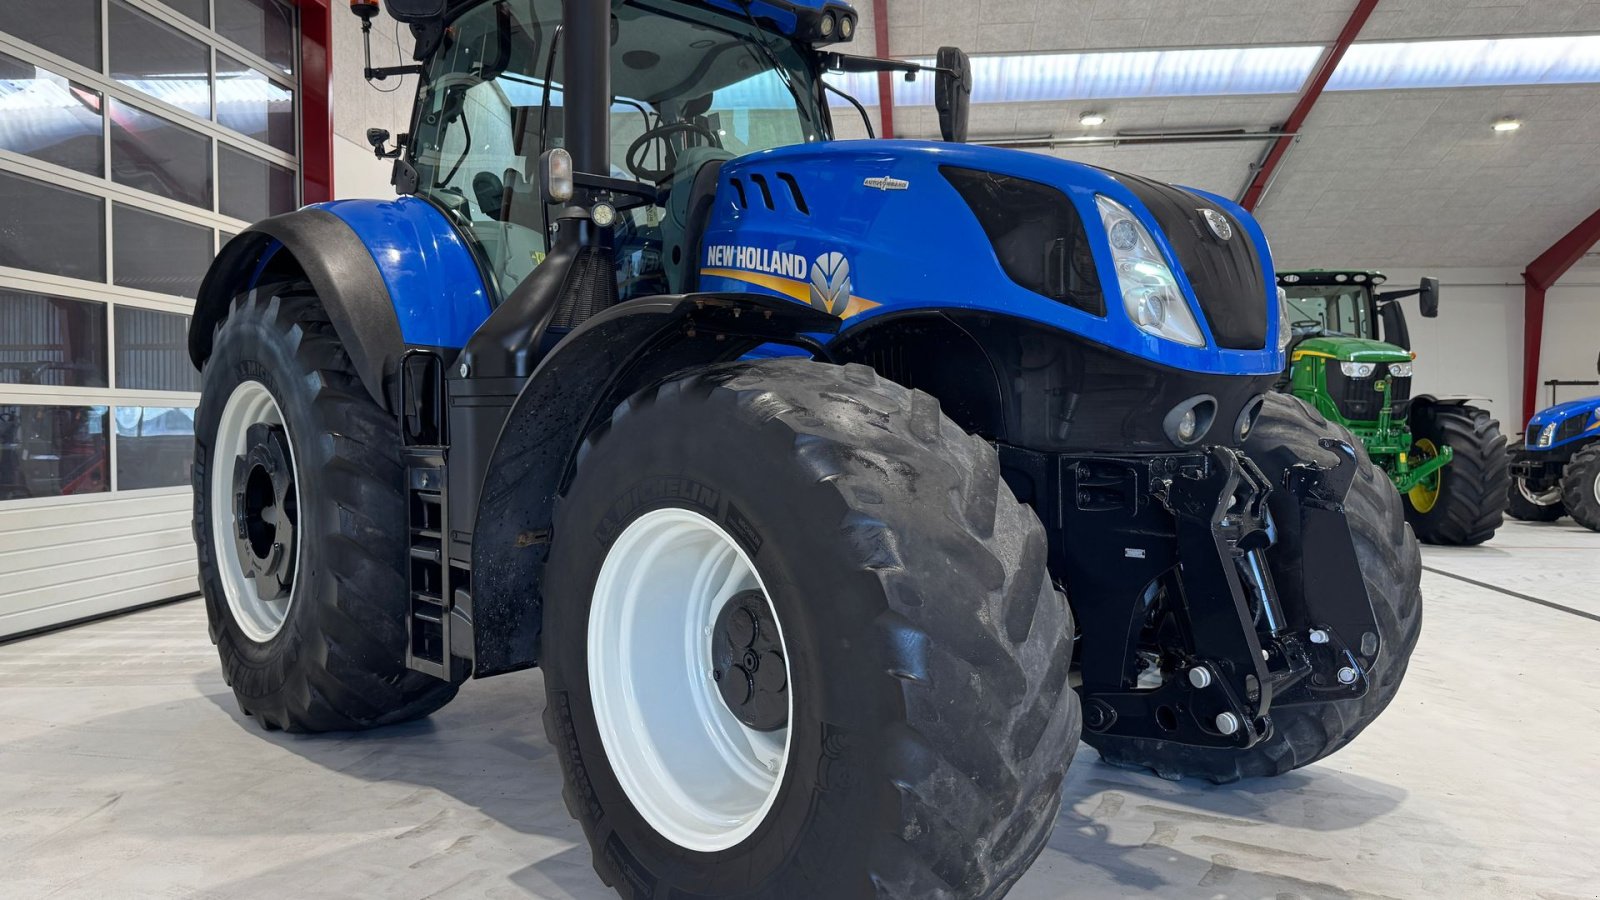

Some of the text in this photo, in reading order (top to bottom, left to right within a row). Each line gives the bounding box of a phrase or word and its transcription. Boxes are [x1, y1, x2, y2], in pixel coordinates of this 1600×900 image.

[707, 245, 807, 279] NEW HOLLAND
[613, 478, 721, 522] MICHELIN
